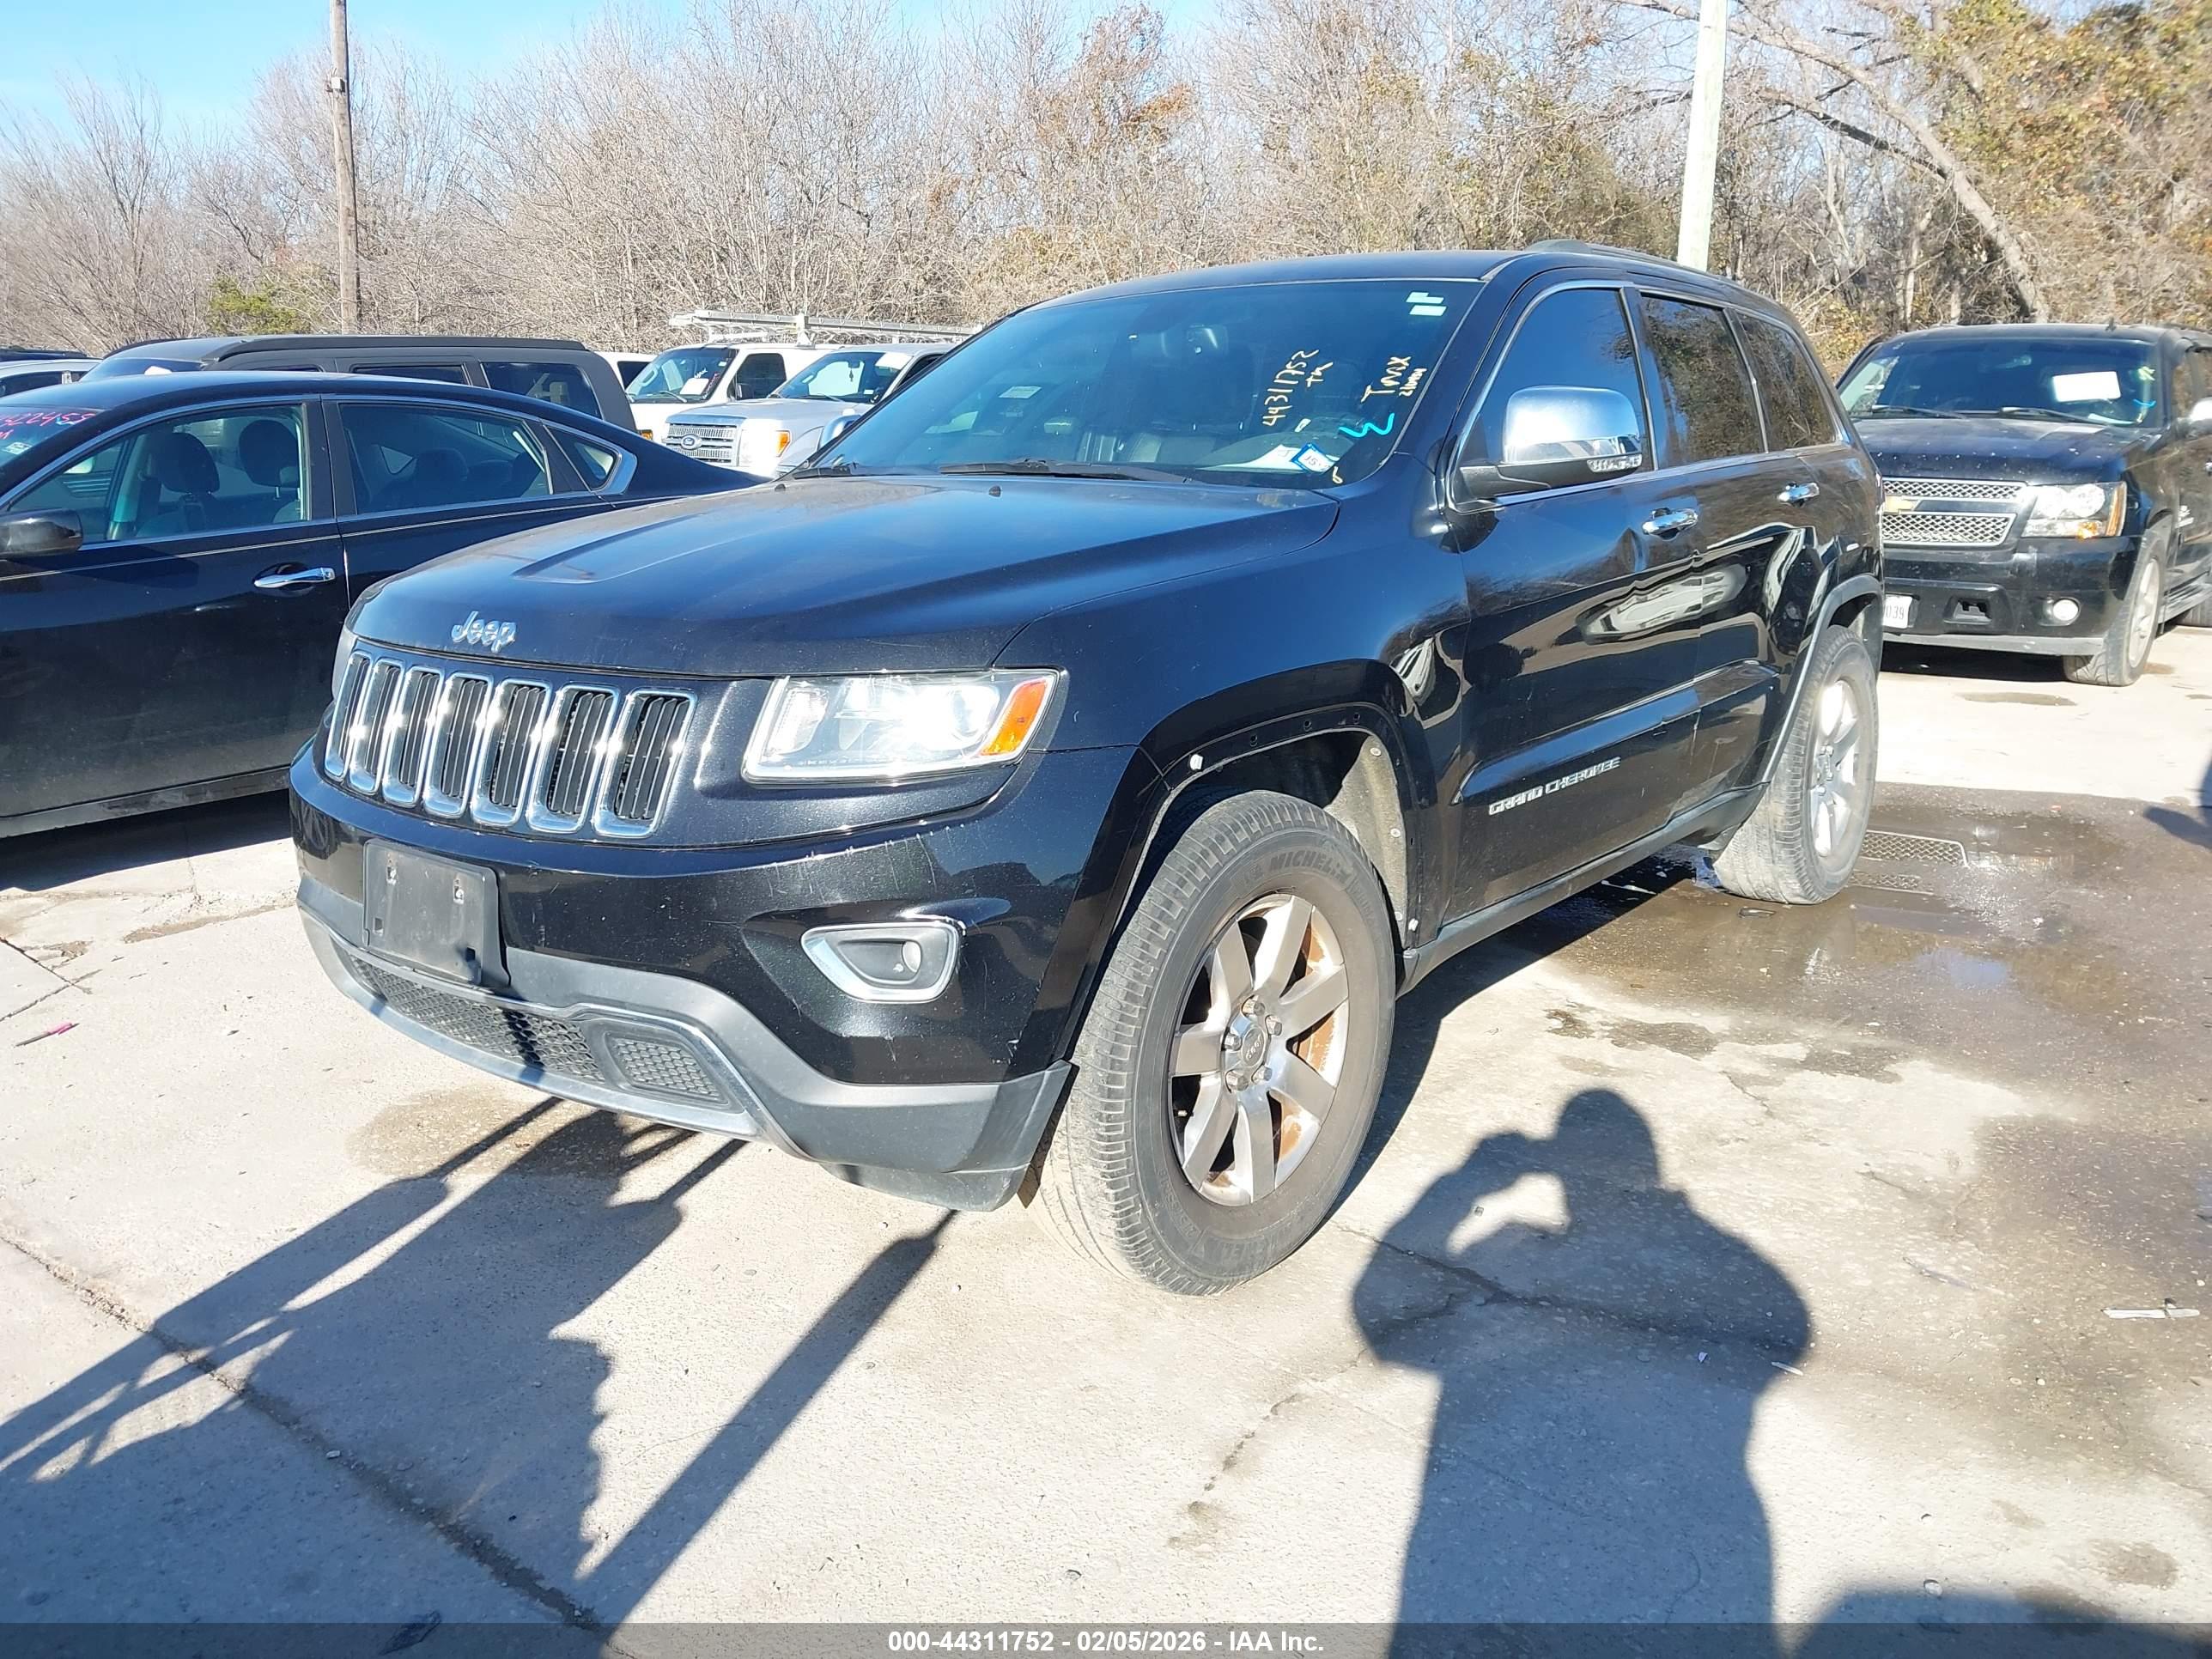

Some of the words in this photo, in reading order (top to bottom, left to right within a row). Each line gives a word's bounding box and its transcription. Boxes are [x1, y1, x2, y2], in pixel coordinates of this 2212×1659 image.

[451, 611, 517, 653] Jeep
[1488, 785, 1544, 816] GRAND
[1545, 756, 1622, 794] CHEROKEE
